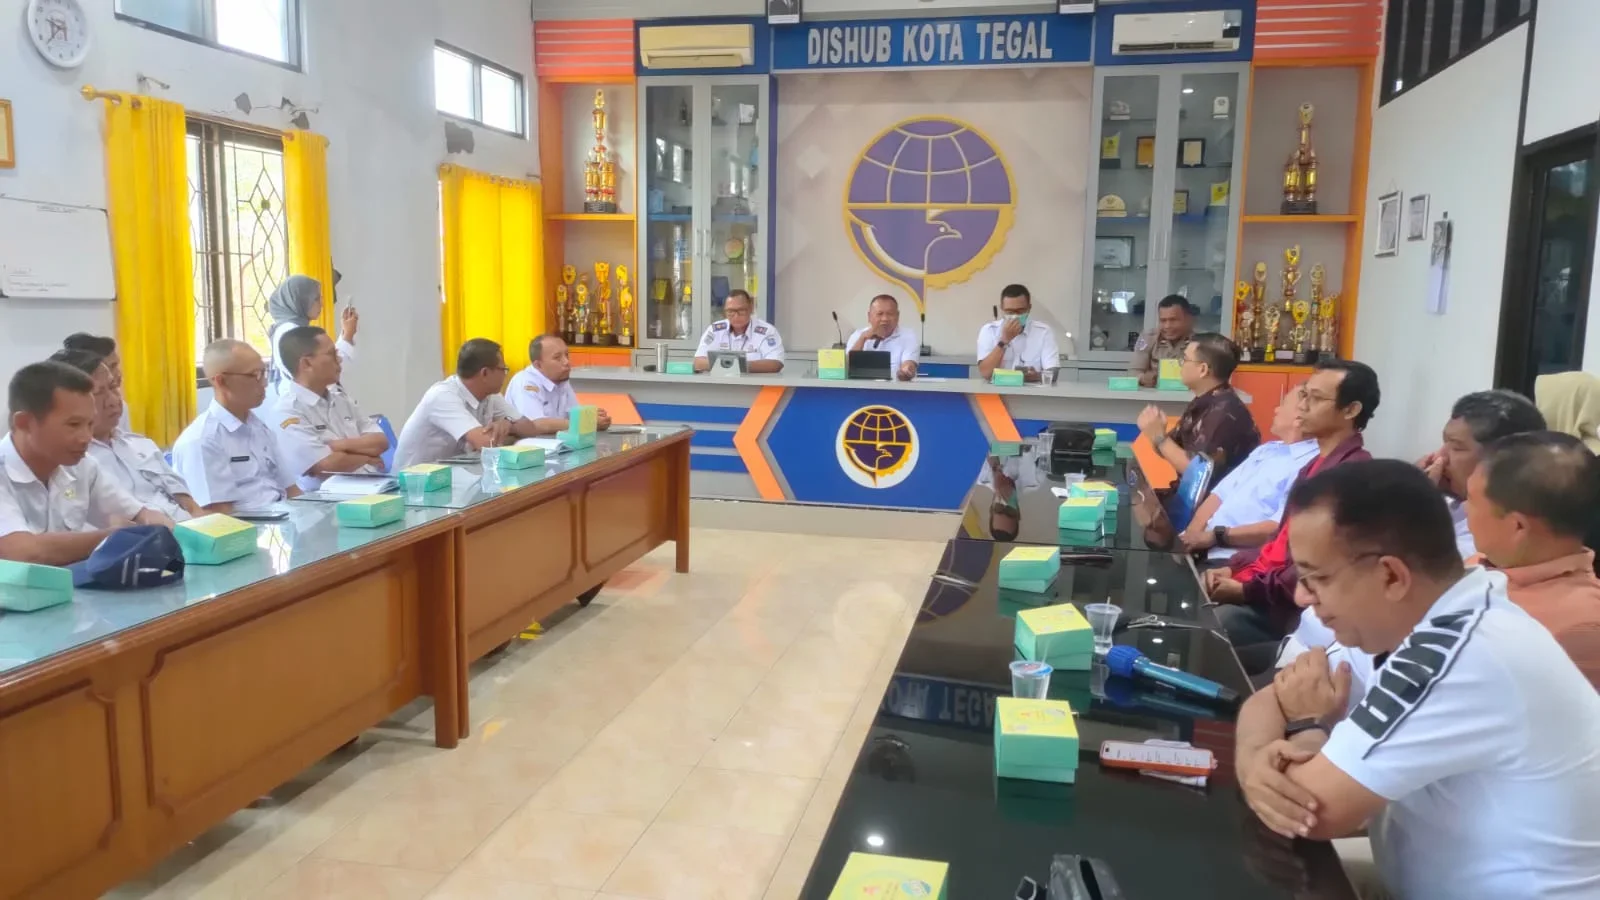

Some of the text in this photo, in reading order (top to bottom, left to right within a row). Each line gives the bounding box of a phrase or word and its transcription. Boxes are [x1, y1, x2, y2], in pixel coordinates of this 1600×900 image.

[807, 21, 1053, 65] DISHUB KOTA TEGAL
